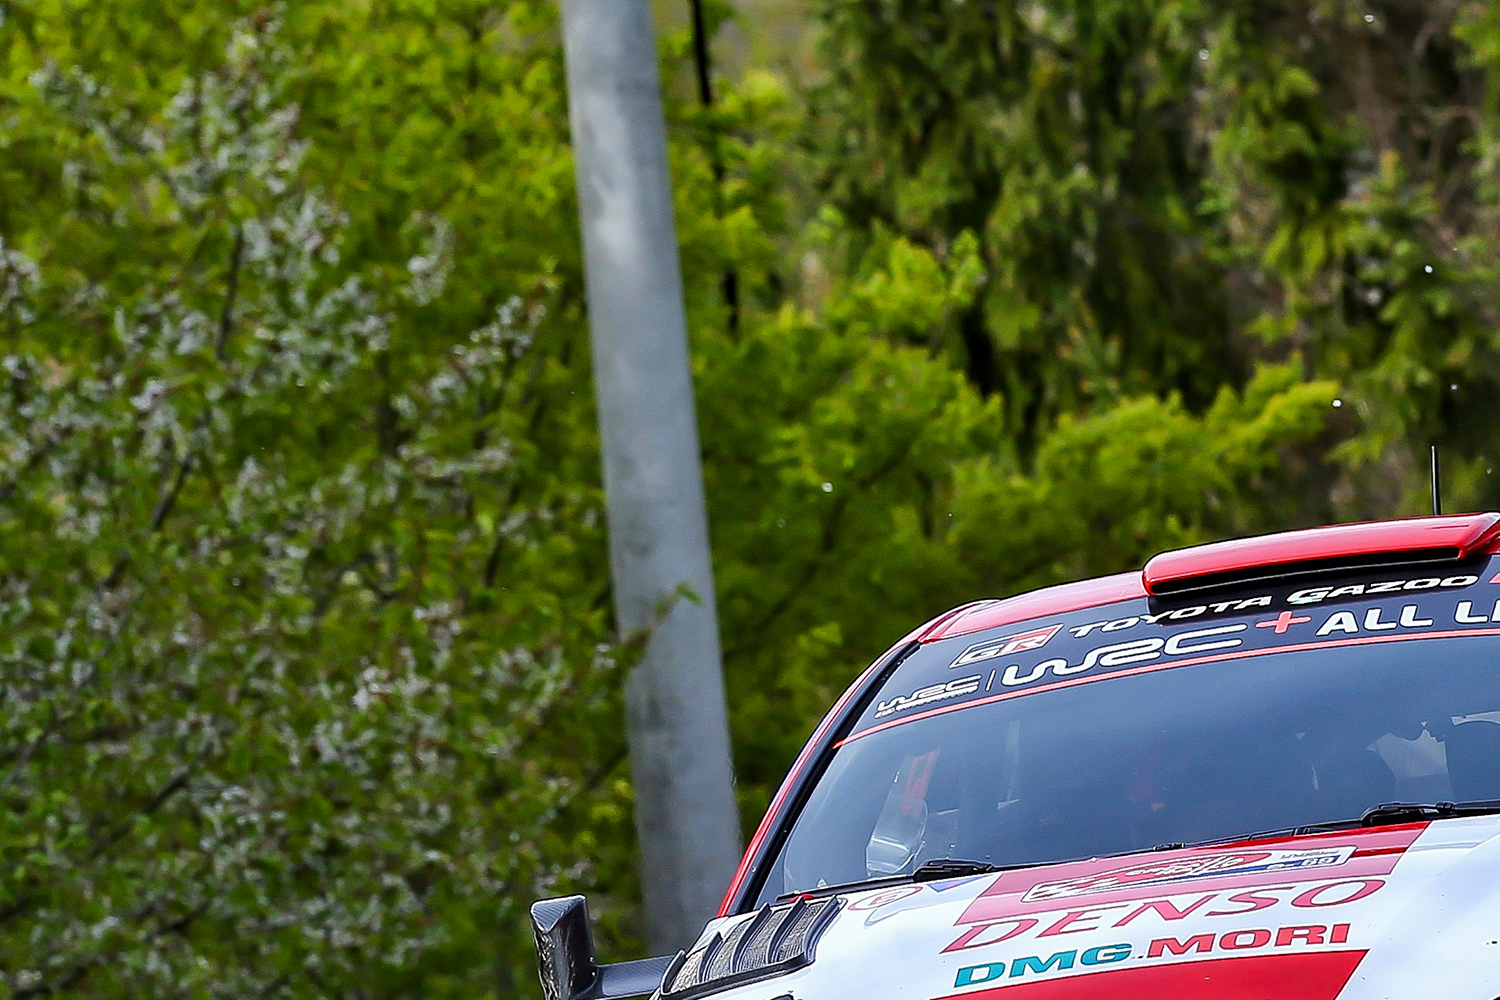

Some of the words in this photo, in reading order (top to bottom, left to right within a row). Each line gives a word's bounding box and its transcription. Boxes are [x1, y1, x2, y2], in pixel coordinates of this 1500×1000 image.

[1069, 593, 1272, 638] TOYOTA
[1286, 573, 1480, 605] GAZOO
[877, 674, 982, 711] WRC
[1315, 604, 1434, 637] ALL
[938, 878, 1388, 954] DENSO
[953, 943, 1133, 988] DMG
[1147, 922, 1352, 959] MORI
